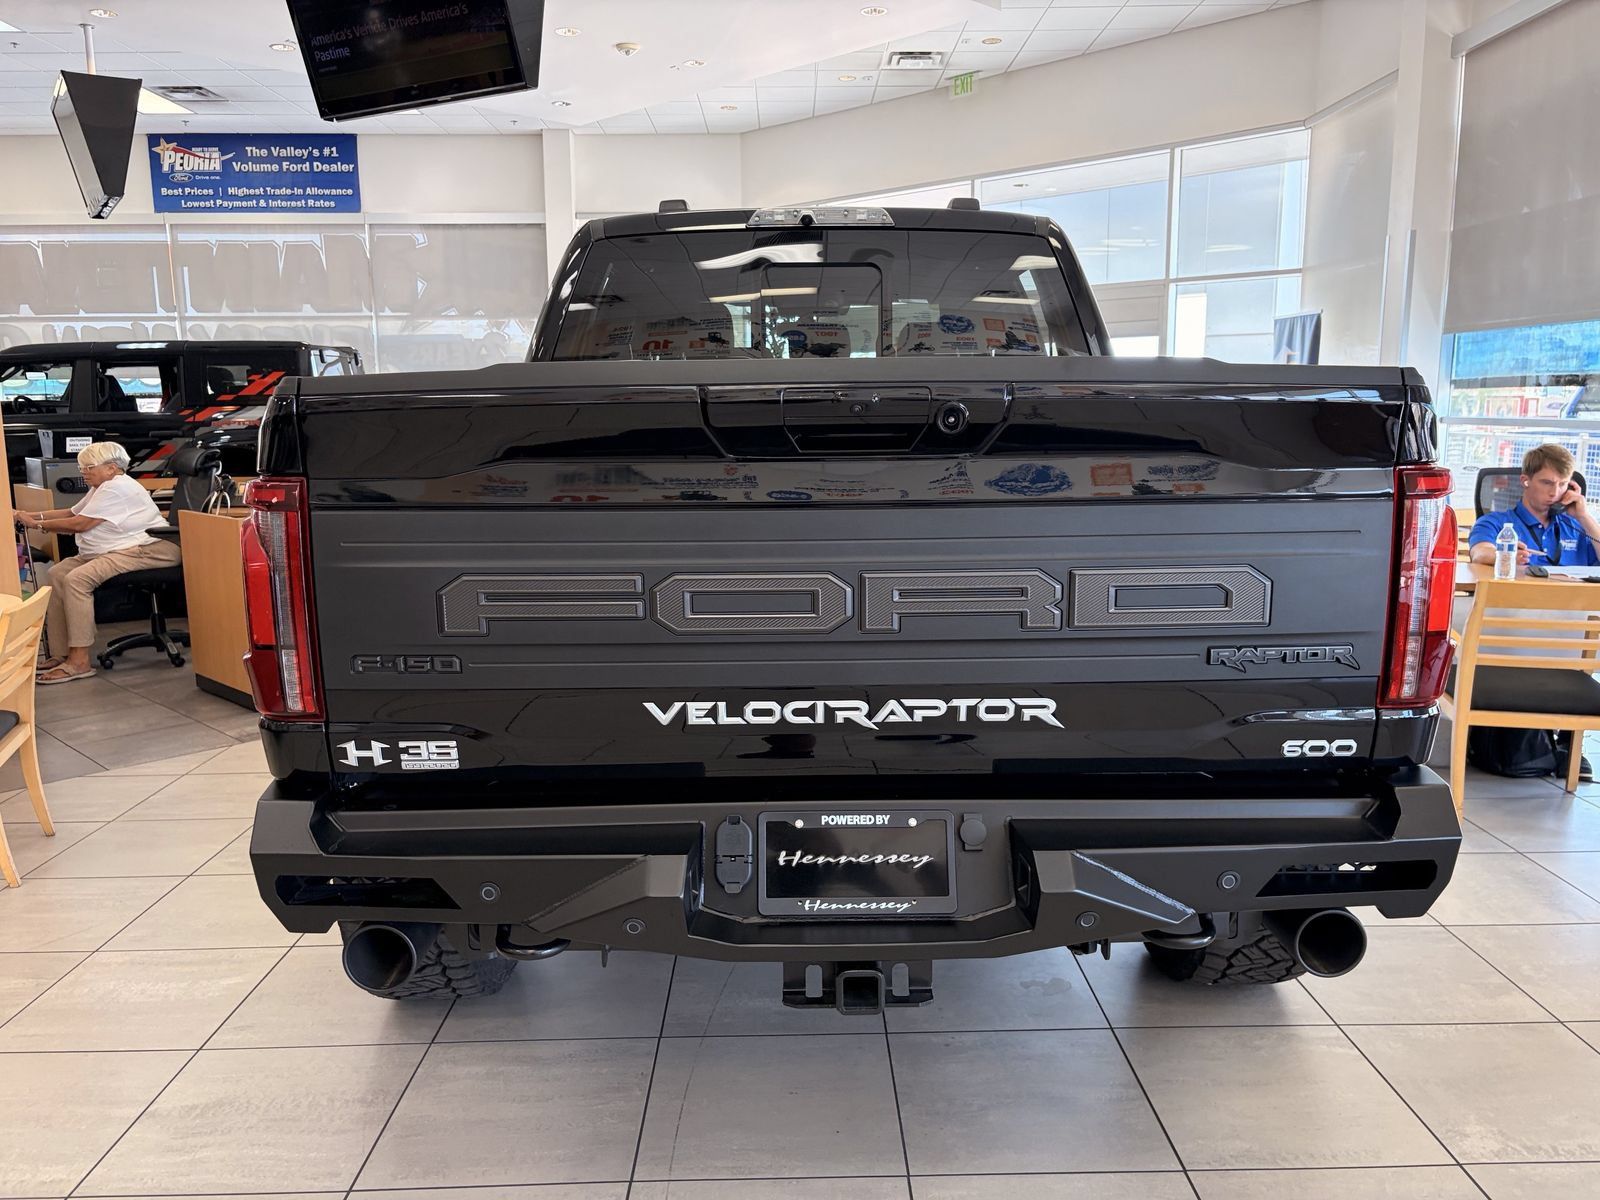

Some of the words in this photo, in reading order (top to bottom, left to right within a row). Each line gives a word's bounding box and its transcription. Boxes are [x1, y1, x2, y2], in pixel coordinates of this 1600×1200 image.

[388, 13, 420, 30] Drives
[420, 4, 469, 23] America's
[314, 47, 351, 62] Pastime
[953, 75, 974, 96] EXIT
[245, 146, 268, 157] The
[270, 146, 320, 159] Valley's
[322, 146, 339, 157] #1
[232, 161, 280, 172] Volume
[282, 161, 310, 172] Ford
[313, 161, 355, 172] Dealer
[160, 187, 182, 196] Best
[184, 187, 214, 196] Prices
[227, 187, 265, 197] Highest
[266, 187, 304, 196] Trade-In
[305, 187, 353, 196] Allowance
[181, 199, 215, 208] Lowest
[216, 199, 257, 209] Payment
[258, 199, 267, 208] &
[268, 199, 306, 208] Interest
[307, 199, 336, 208] Rates
[436, 564, 1273, 637] FORD
[350, 655, 462, 674] F-150
[1206, 642, 1361, 673] RAPTOR
[642, 697, 1066, 730] VELOCIRAPTOR
[398, 740, 459, 760] 35
[1281, 738, 1358, 757] 600
[821, 814, 875, 826] POWERED
[875, 814, 890, 826] BY
[778, 850, 934, 868] Hennessey
[803, 898, 912, 912] Hennessey
